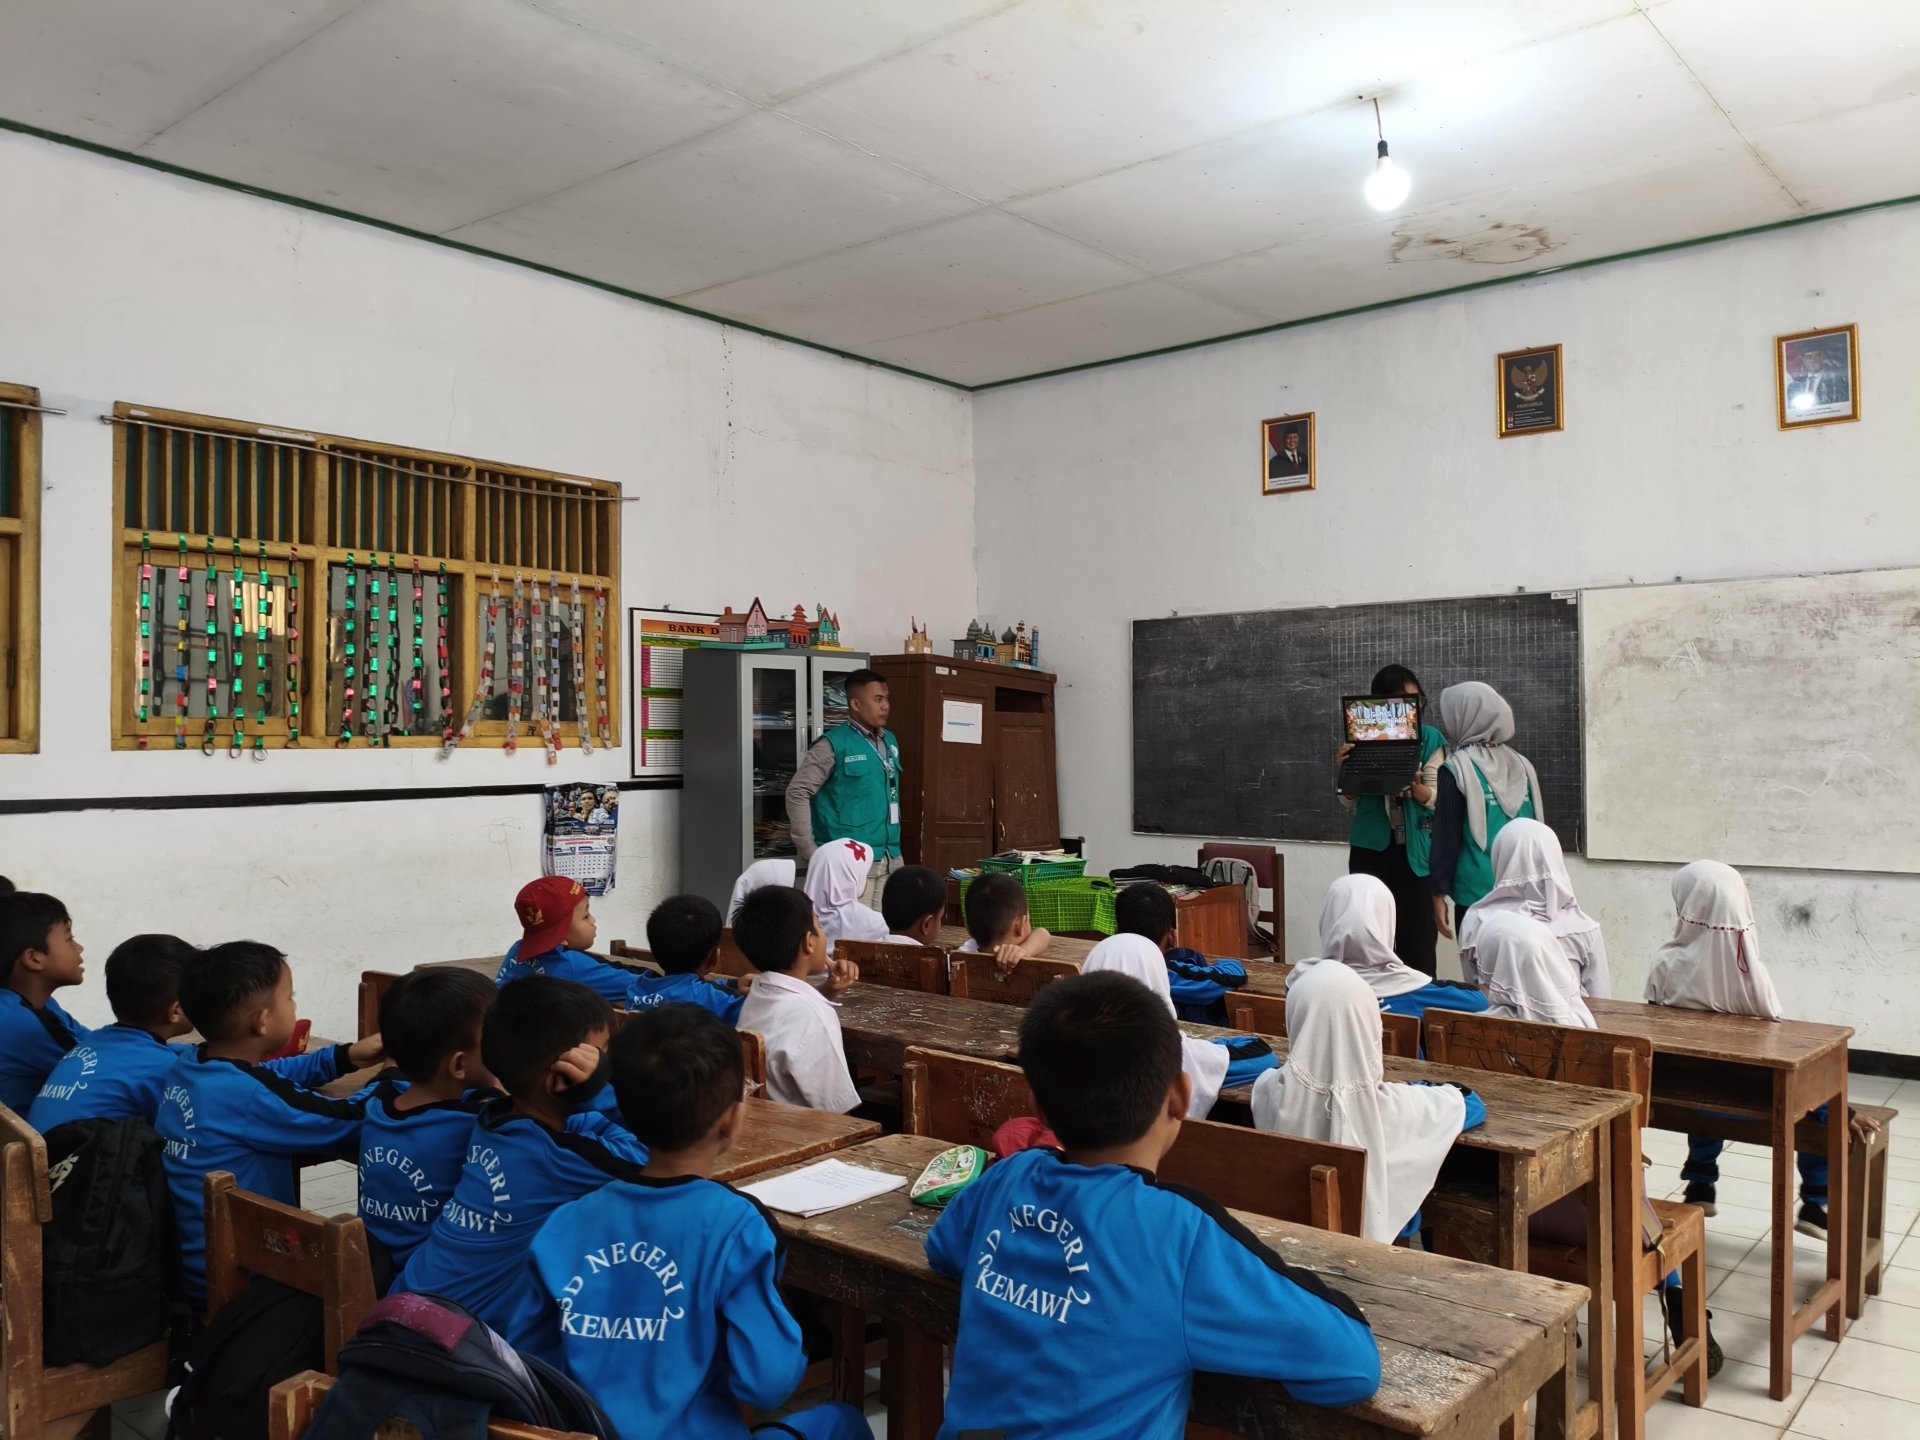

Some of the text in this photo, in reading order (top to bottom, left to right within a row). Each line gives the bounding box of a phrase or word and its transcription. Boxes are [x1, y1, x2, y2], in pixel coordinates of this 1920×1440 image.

[668, 623, 705, 634] BANK
[37, 1084, 76, 1101] MAWI
[364, 1146, 439, 1208] NEGERI 2
[464, 1145, 513, 1223] EGERI 2
[556, 1241, 685, 1320] SD NEGERI 2
[977, 1229, 1001, 1269] SD
[1008, 1204, 1090, 1275] NEGERI
[1066, 1286, 1091, 1306] 2
[974, 1267, 1073, 1324] KEMAWI
[560, 1310, 669, 1342] KEMAWI
